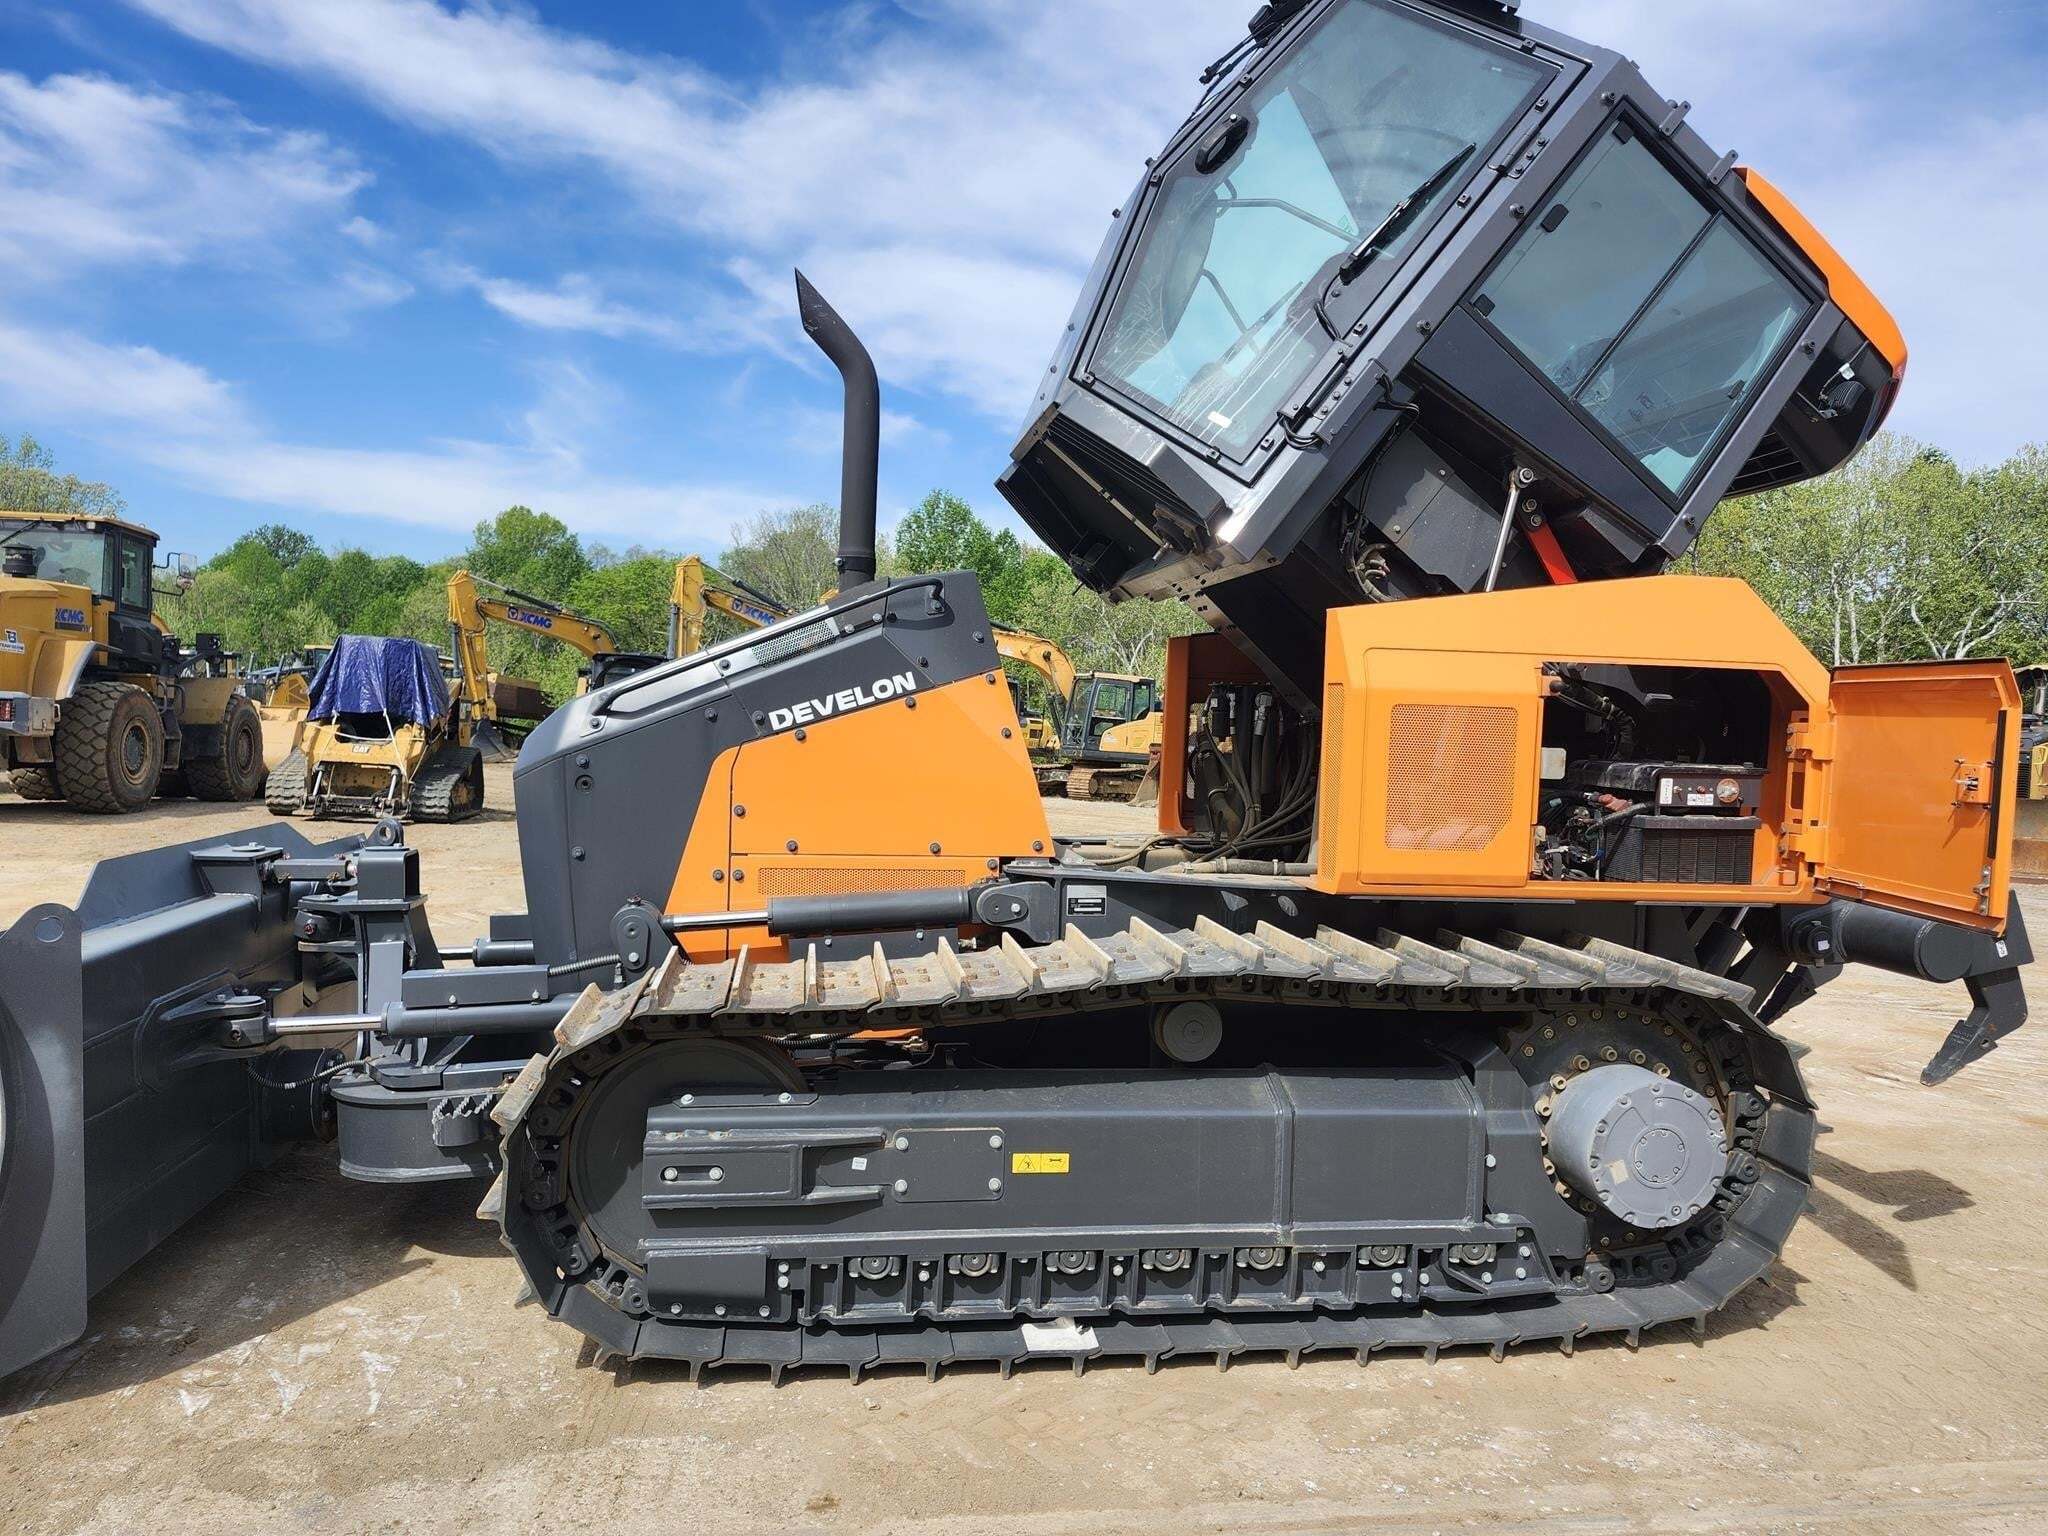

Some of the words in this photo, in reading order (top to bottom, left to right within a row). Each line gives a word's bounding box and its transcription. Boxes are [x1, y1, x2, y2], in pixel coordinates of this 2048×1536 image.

[520, 611, 552, 628] XCMG
[744, 604, 776, 625] XCMG
[768, 671, 917, 731] DEVELON
